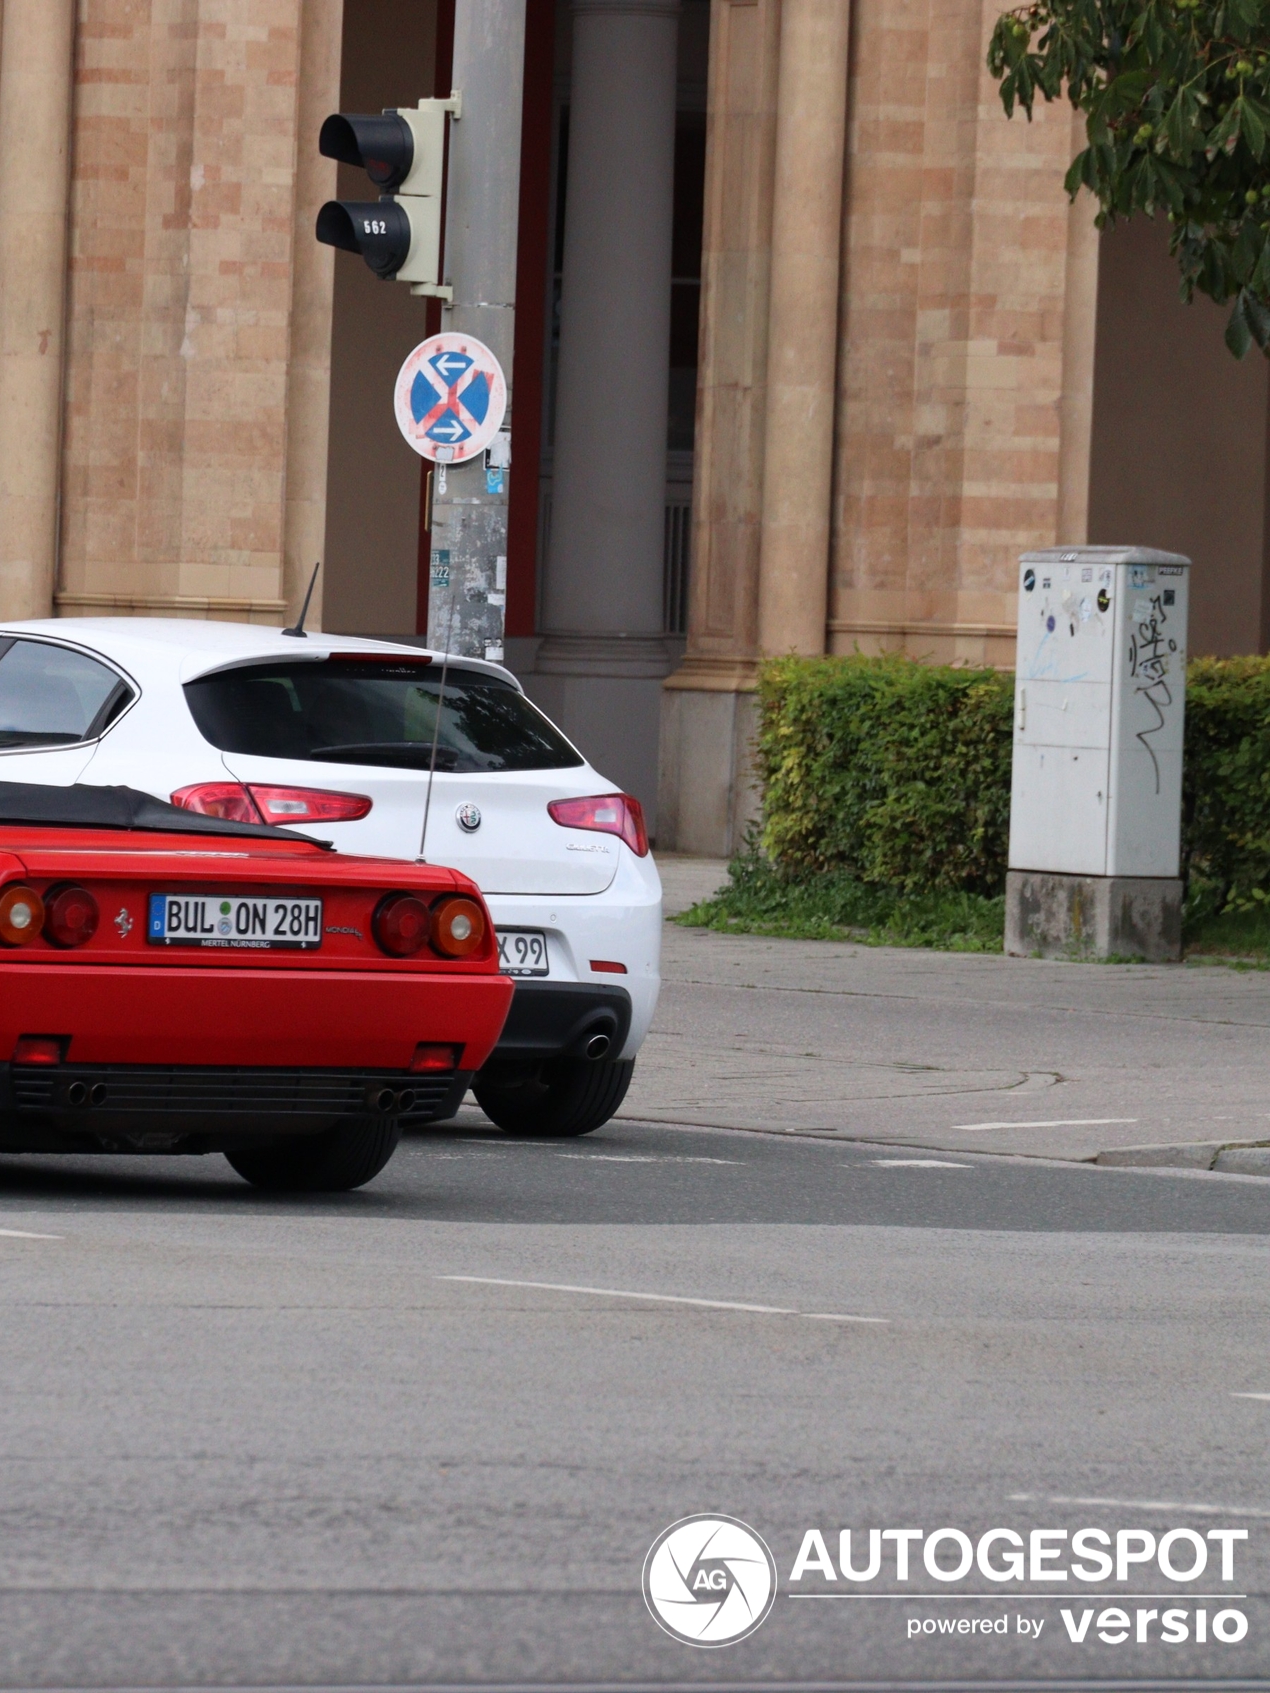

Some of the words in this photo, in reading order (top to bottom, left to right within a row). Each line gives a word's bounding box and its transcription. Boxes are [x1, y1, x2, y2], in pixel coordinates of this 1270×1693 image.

[364, 220, 386, 234] 562
[167, 900, 214, 933] BUL
[235, 902, 267, 935] ON
[273, 904, 319, 937] 28H
[201, 939, 229, 948] MERTEL
[230, 939, 271, 949] NÜRNBERG
[515, 936, 542, 965] 99
